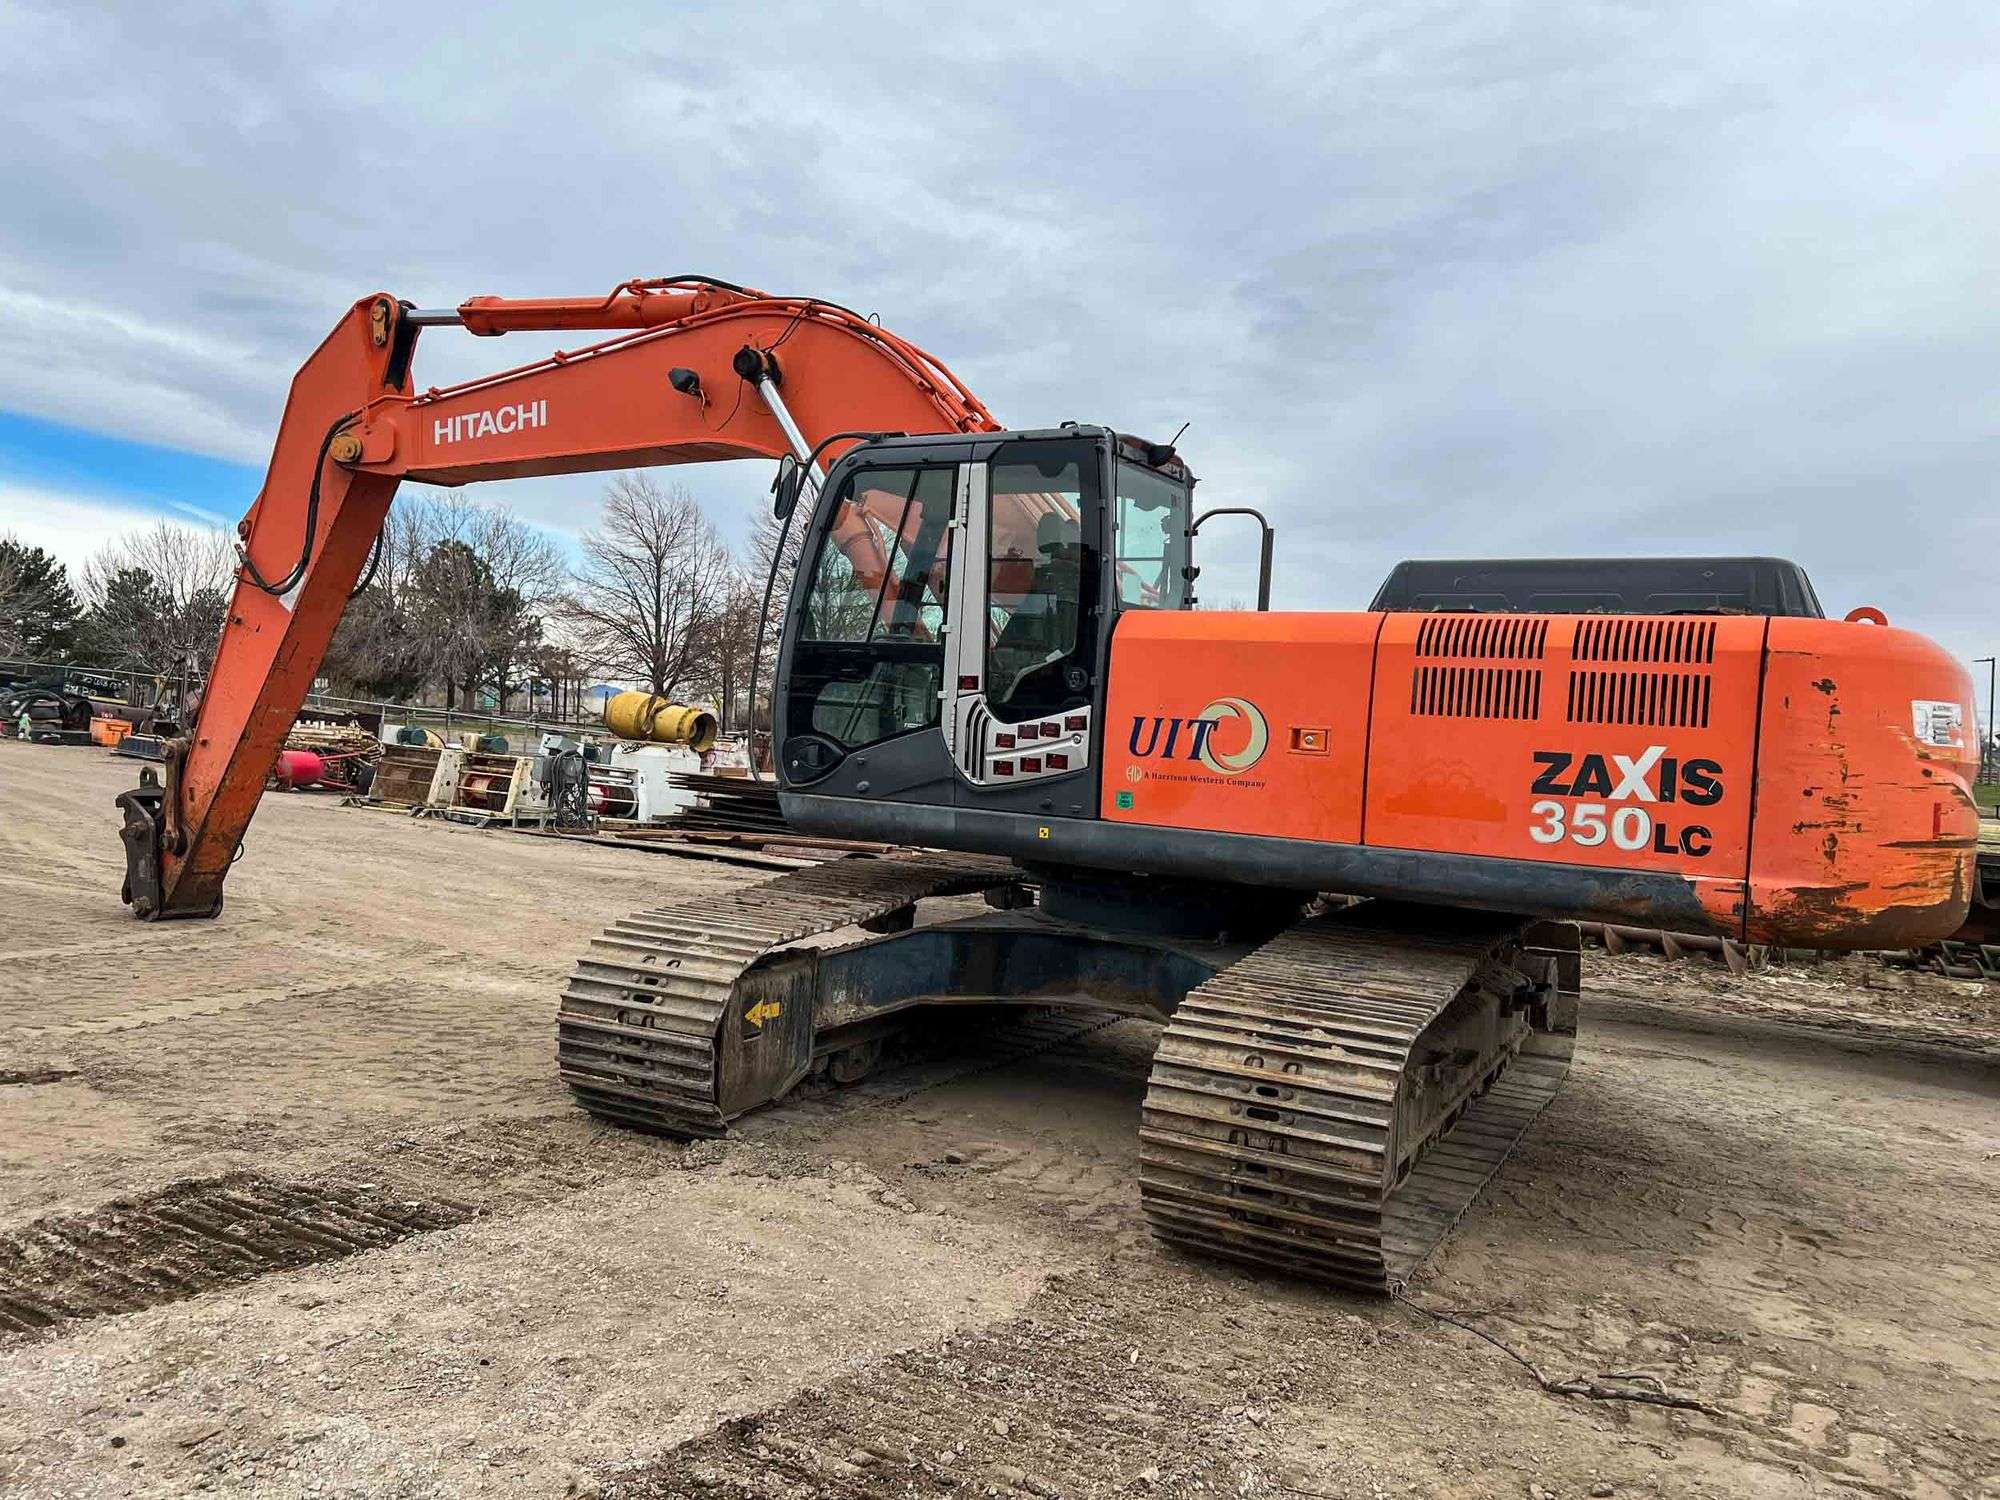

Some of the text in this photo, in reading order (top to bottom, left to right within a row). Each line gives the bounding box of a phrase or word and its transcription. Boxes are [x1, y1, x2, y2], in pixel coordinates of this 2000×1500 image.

[434, 399, 547, 445] HITACHI
[1129, 716, 1220, 760] UIT
[1152, 772, 1188, 782] Harrison
[1190, 775, 1225, 785] Western
[1226, 776, 1267, 789] Company
[1531, 745, 1724, 806] ZAXIS
